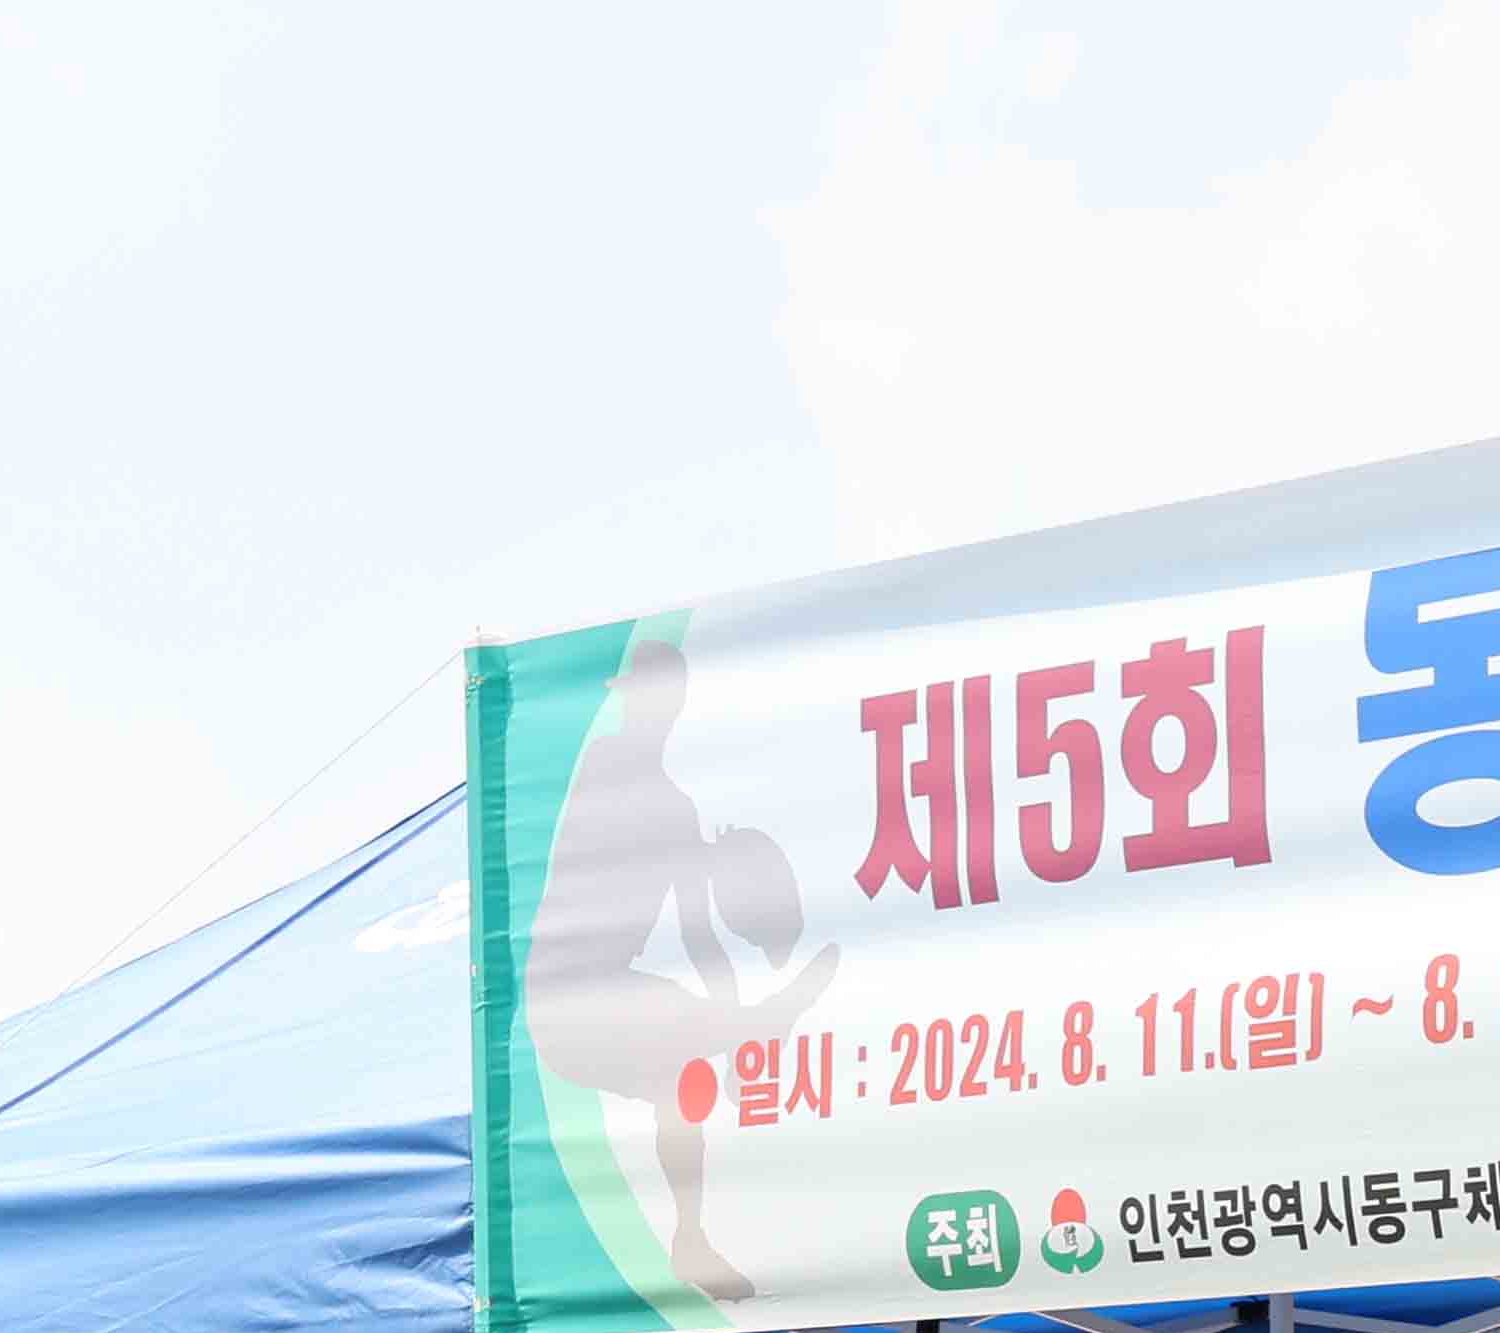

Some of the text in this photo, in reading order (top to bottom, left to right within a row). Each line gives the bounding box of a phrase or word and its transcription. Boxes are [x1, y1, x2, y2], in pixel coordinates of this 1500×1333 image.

[855, 626, 1271, 910] 제5회
[735, 1033, 833, 1127] 일시
[889, 1009, 1038, 1106] 2024.
[1061, 1001, 1107, 1087] 8.
[1135, 972, 1325, 1076] 11.(일)
[1422, 953, 1475, 1045] 8.
[925, 1203, 1004, 1278] 주최
